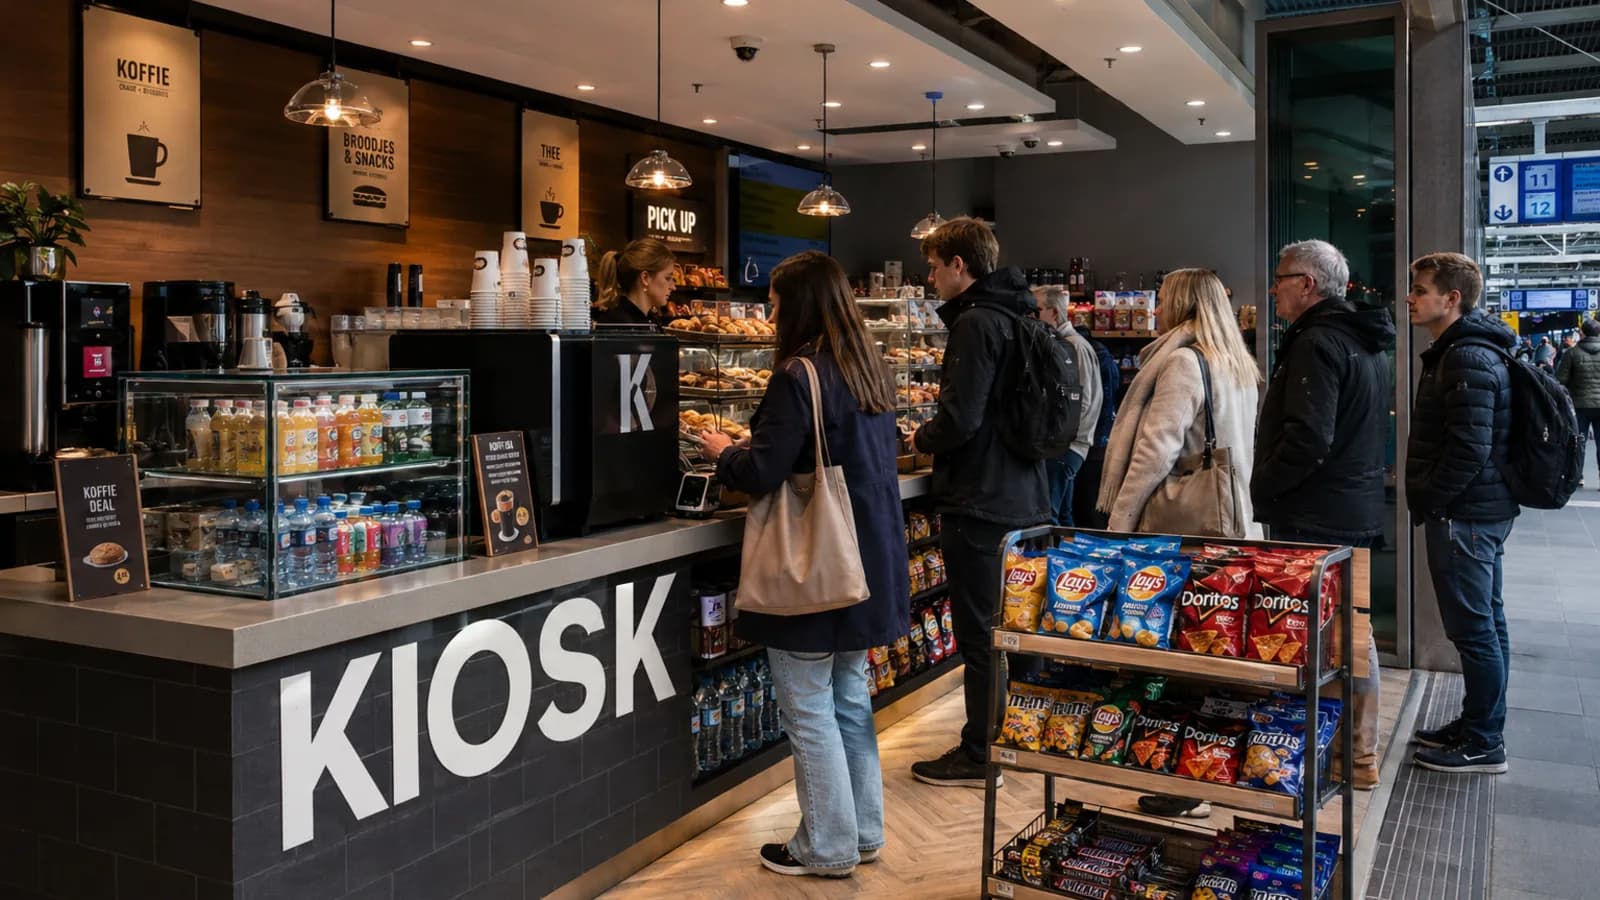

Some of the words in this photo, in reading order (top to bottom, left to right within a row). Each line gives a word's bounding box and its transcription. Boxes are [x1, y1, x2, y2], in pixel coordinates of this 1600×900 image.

[117, 58, 169, 86] KOFFIE
[344, 132, 394, 154] BROODJES
[541, 144, 560, 160] THEE
[345, 149, 351, 164] &
[355, 151, 394, 170] SNACKS
[1530, 173, 1548, 187] 11
[1530, 201, 1551, 216] 12
[647, 205, 676, 232] PICK
[680, 210, 696, 234] UP
[616, 353, 655, 434] K
[83, 484, 117, 499] KOFFIE
[90, 499, 116, 512] DEAL
[1006, 567, 1036, 586] Lay's
[1057, 572, 1096, 592] Lay's
[1128, 571, 1166, 592] Lay's
[1181, 591, 1239, 610] Doritos
[1254, 594, 1309, 613] Doritos
[280, 572, 677, 852] KIOSK
[1184, 726, 1237, 748] Doritos
